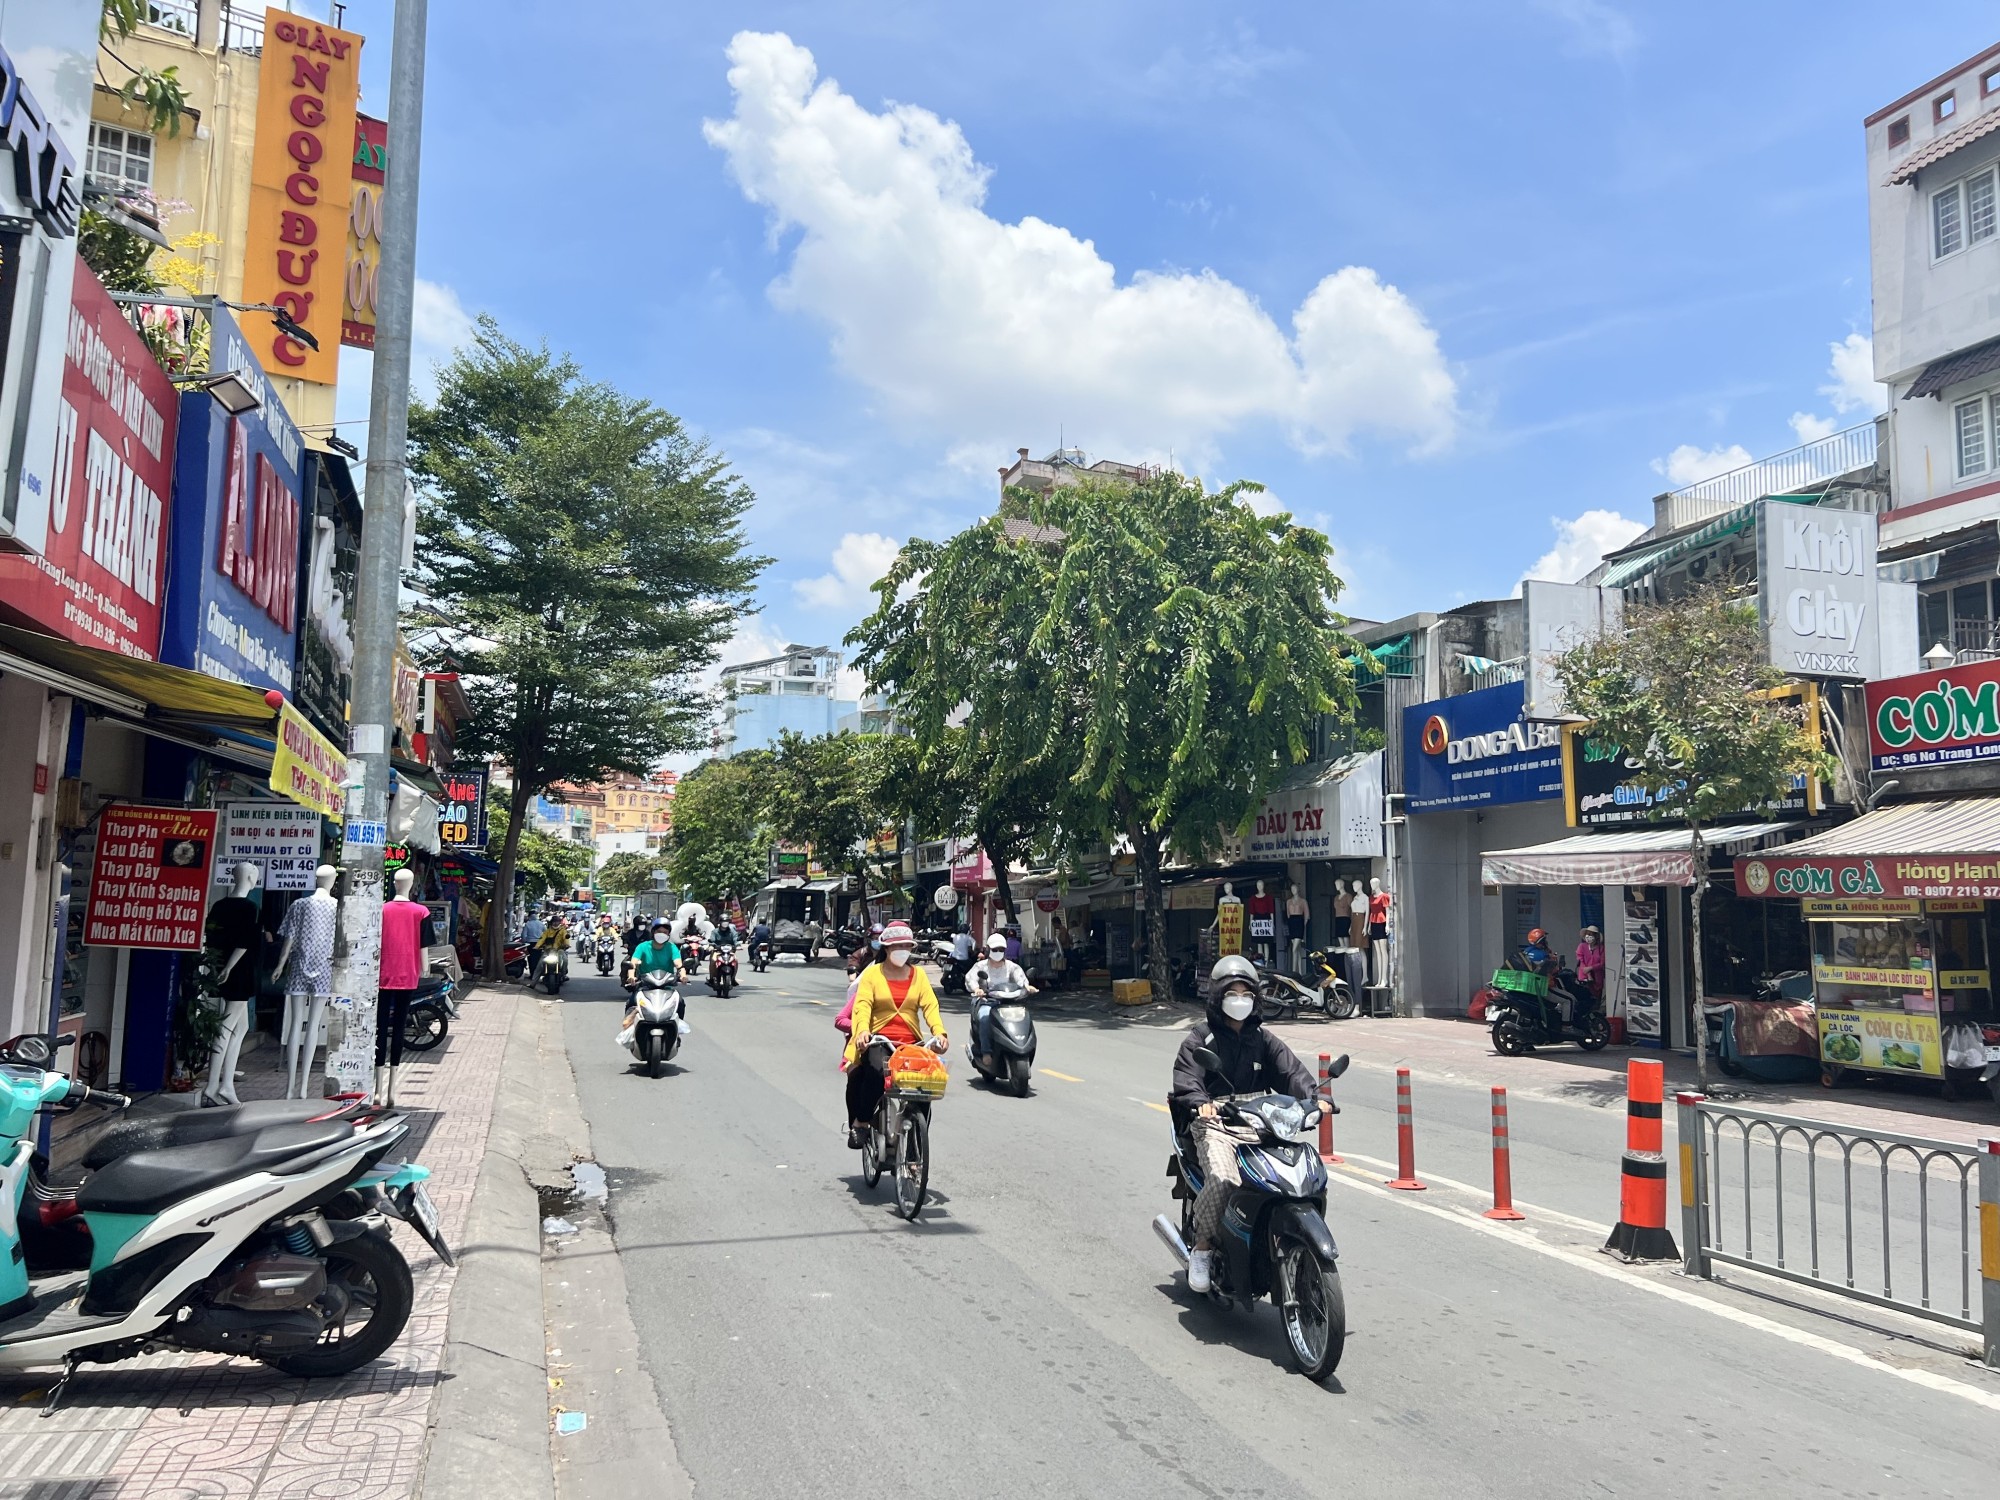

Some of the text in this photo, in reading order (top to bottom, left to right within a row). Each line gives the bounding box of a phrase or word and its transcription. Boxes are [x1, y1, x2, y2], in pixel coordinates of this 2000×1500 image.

[275, 20, 351, 60] GIÀY
[285, 56, 330, 206] NGỌC
[82, 427, 162, 605] THÀNH
[1794, 651, 1859, 674] VNXK
[1877, 679, 2000, 747] CƠM
[1525, 722, 1561, 750] Ban
[1881, 756, 1900, 766] ĐC:
[1903, 753, 1917, 764] 96
[1920, 751, 1936, 762] Nơ
[1939, 747, 1973, 760] Trang
[232, 808, 319, 824] LINH KIỆN ĐIỆN THOẠI
[1256, 803, 1324, 836] DÂU TÂY
[106, 822, 158, 839] Thay Pin
[161, 822, 209, 837] Adin
[230, 827, 245, 836] SIM
[247, 828, 261, 839] GỌI
[265, 828, 275, 837] 4G
[442, 824, 468, 841] ED
[102, 840, 155, 859] Lau Dầu
[231, 844, 312, 855] THU MUA ĐT CŨ
[101, 861, 160, 880] Thay Dây
[270, 859, 314, 870] SIM 4G
[1896, 860, 2000, 883] Hồng Hạn
[1774, 860, 1884, 894] CƠM GÀ
[98, 881, 200, 902] Thay Kính Saphia
[1925, 886, 1953, 896] 0907
[1956, 886, 1980, 897] 219
[94, 901, 198, 922] Mua Đồng Hồ Xưa
[1811, 903, 1833, 911] CƠM
[1835, 901, 1848, 911] GÀ
[90, 920, 196, 944] Mua Mắt Kính Xưa
[1254, 928, 1271, 936] 49K
[1862, 971, 1877, 982] CANH
[1895, 1018, 1914, 1041] GÀ
